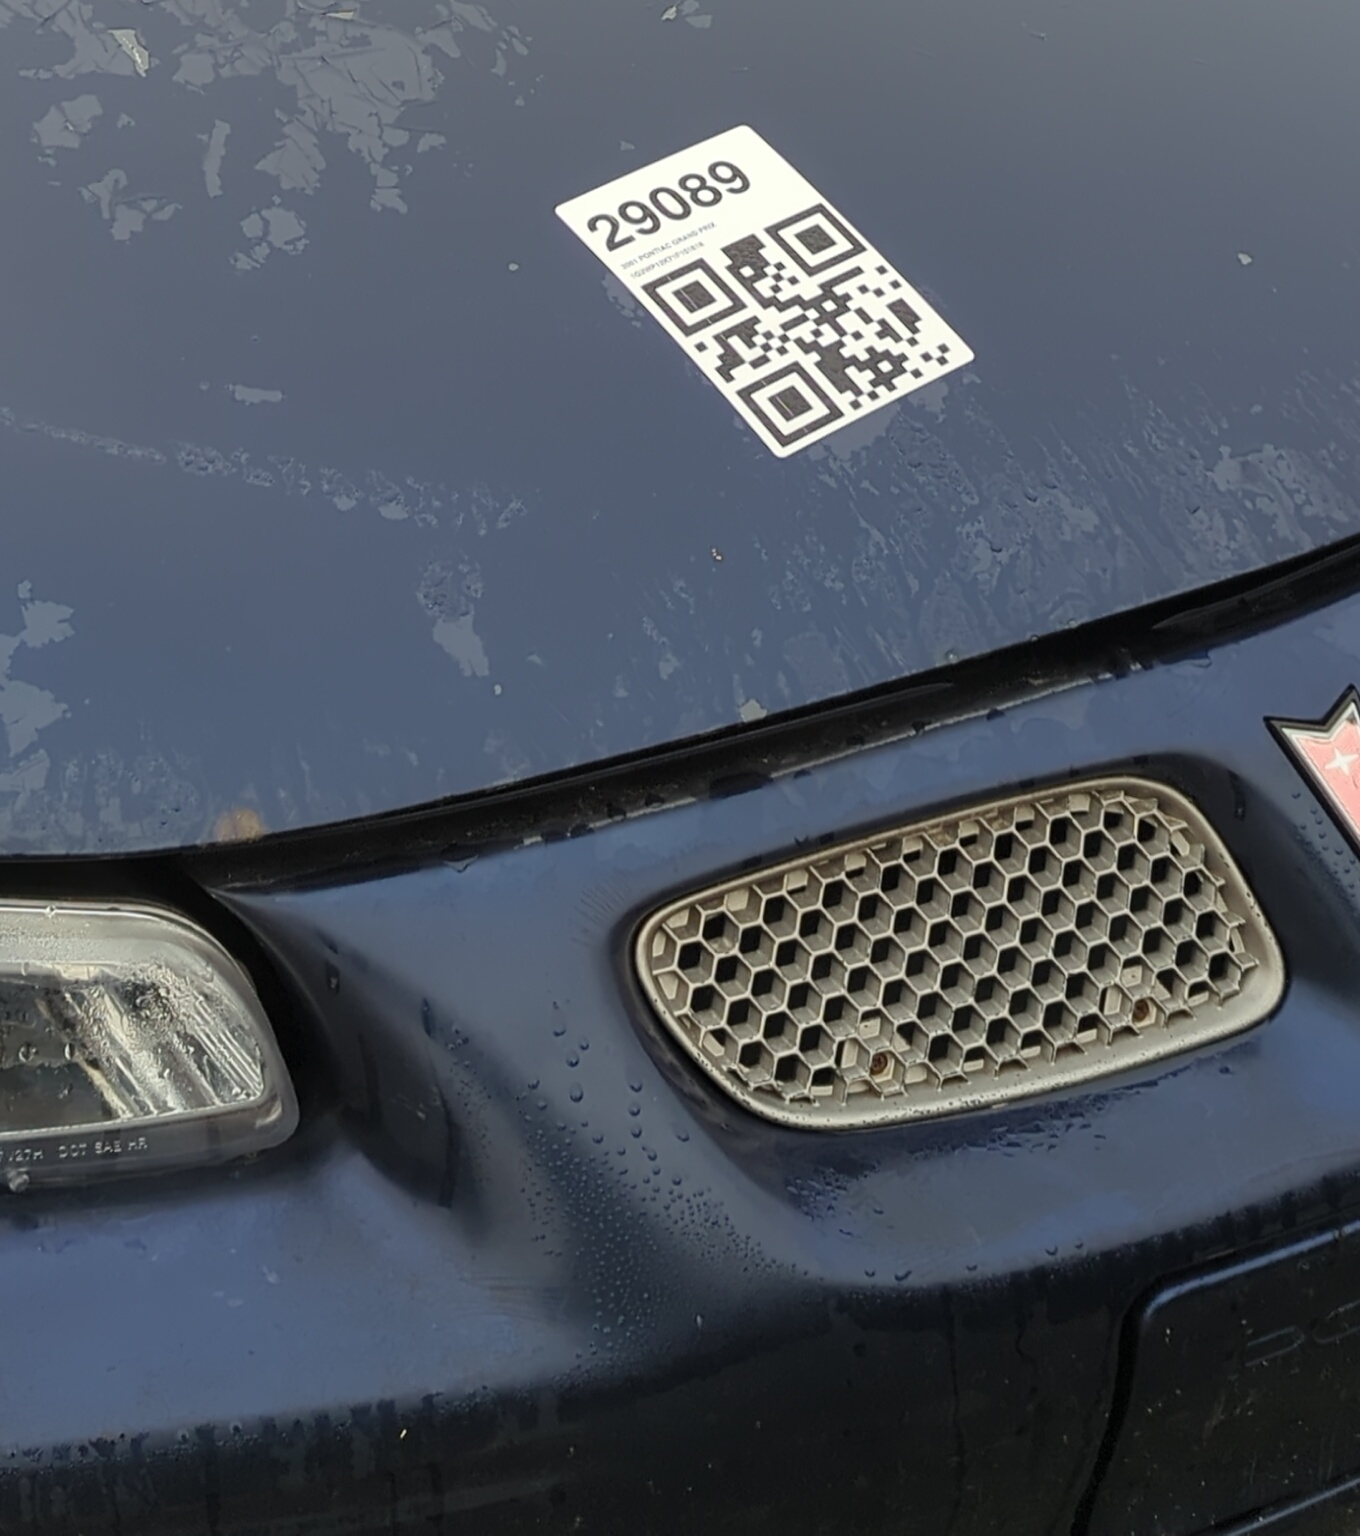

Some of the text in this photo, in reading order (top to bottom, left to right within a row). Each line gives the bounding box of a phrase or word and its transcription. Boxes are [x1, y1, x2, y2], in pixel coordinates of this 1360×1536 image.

[586, 159, 751, 253] 29089
[637, 242, 673, 262] PONTIAC
[671, 229, 699, 247] GRAND
[698, 222, 717, 235] PRIX
[94, 1140, 122, 1154] SAE
